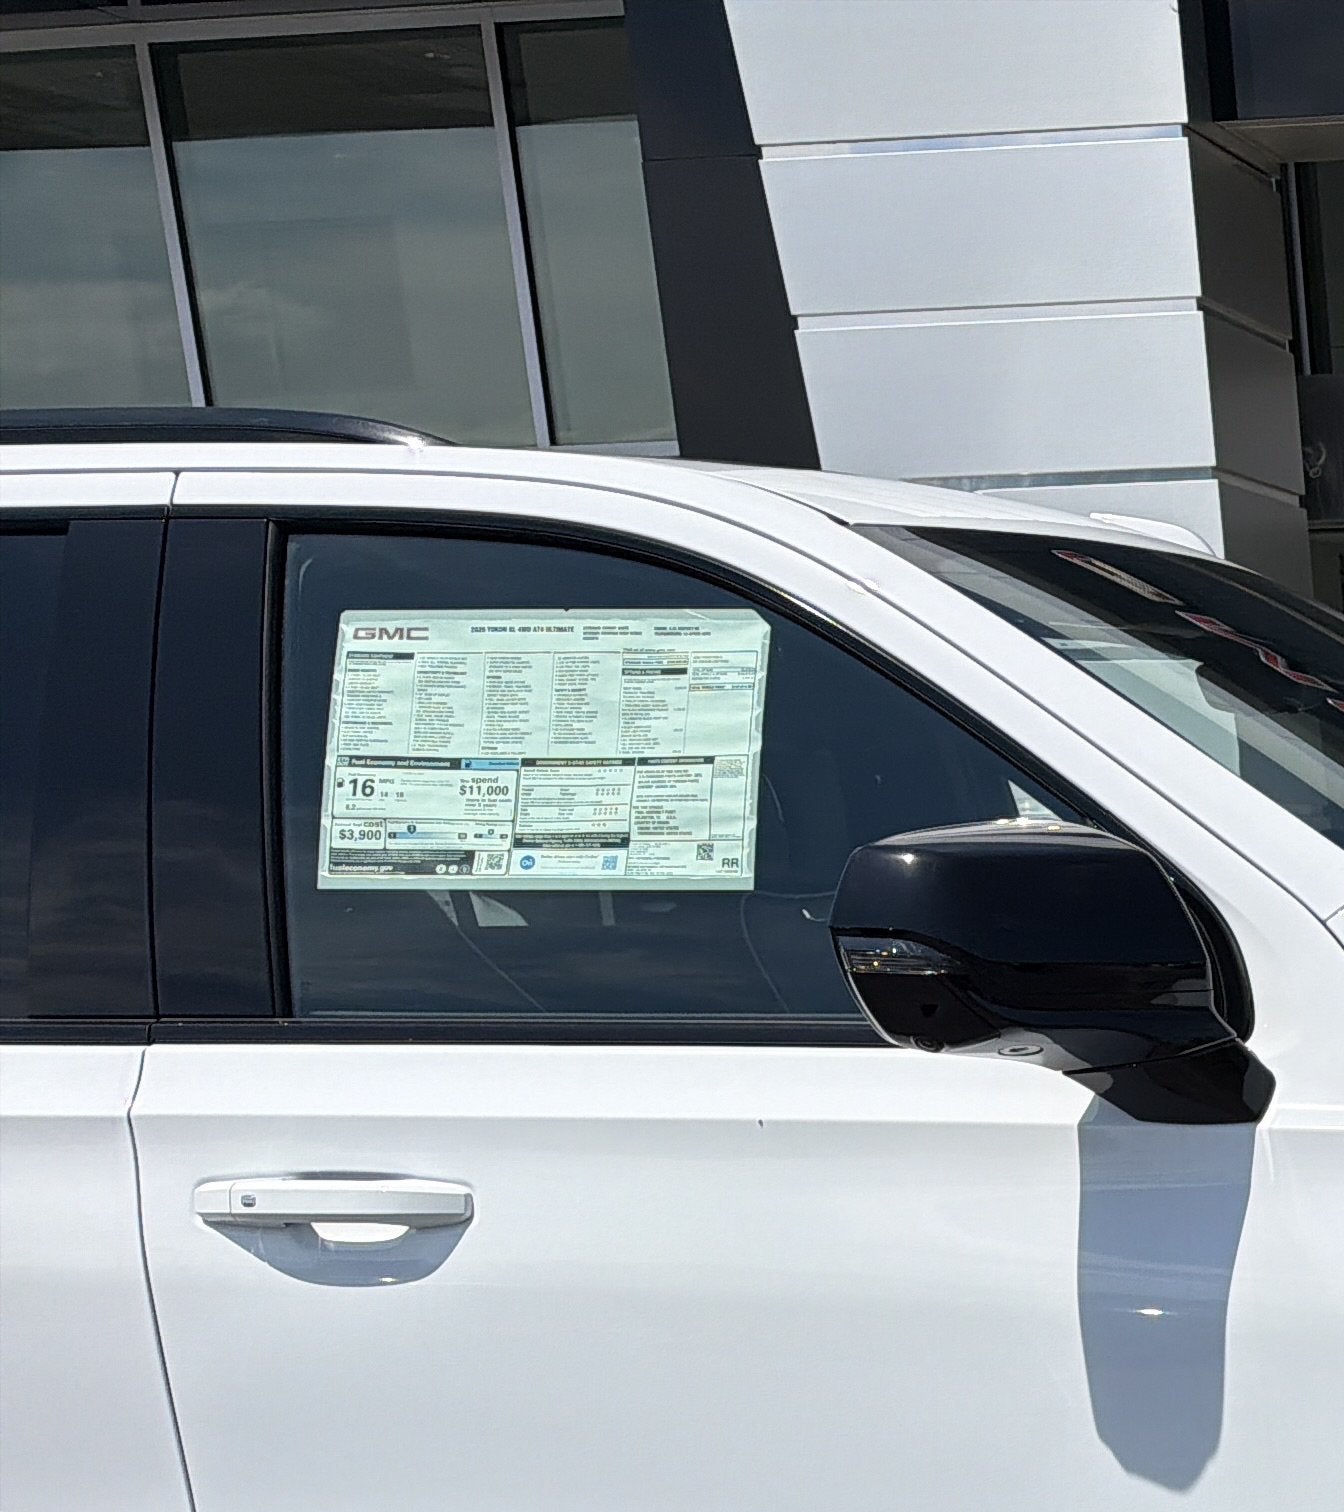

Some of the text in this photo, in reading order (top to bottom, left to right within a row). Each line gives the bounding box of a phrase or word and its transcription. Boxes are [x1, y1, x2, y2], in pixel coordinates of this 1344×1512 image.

[352, 626, 430, 641] GMC
[470, 776, 499, 784] spend
[348, 778, 375, 797] 16
[459, 785, 509, 797] $11,000
[339, 829, 382, 841] $3,900
[721, 857, 739, 868] RR
